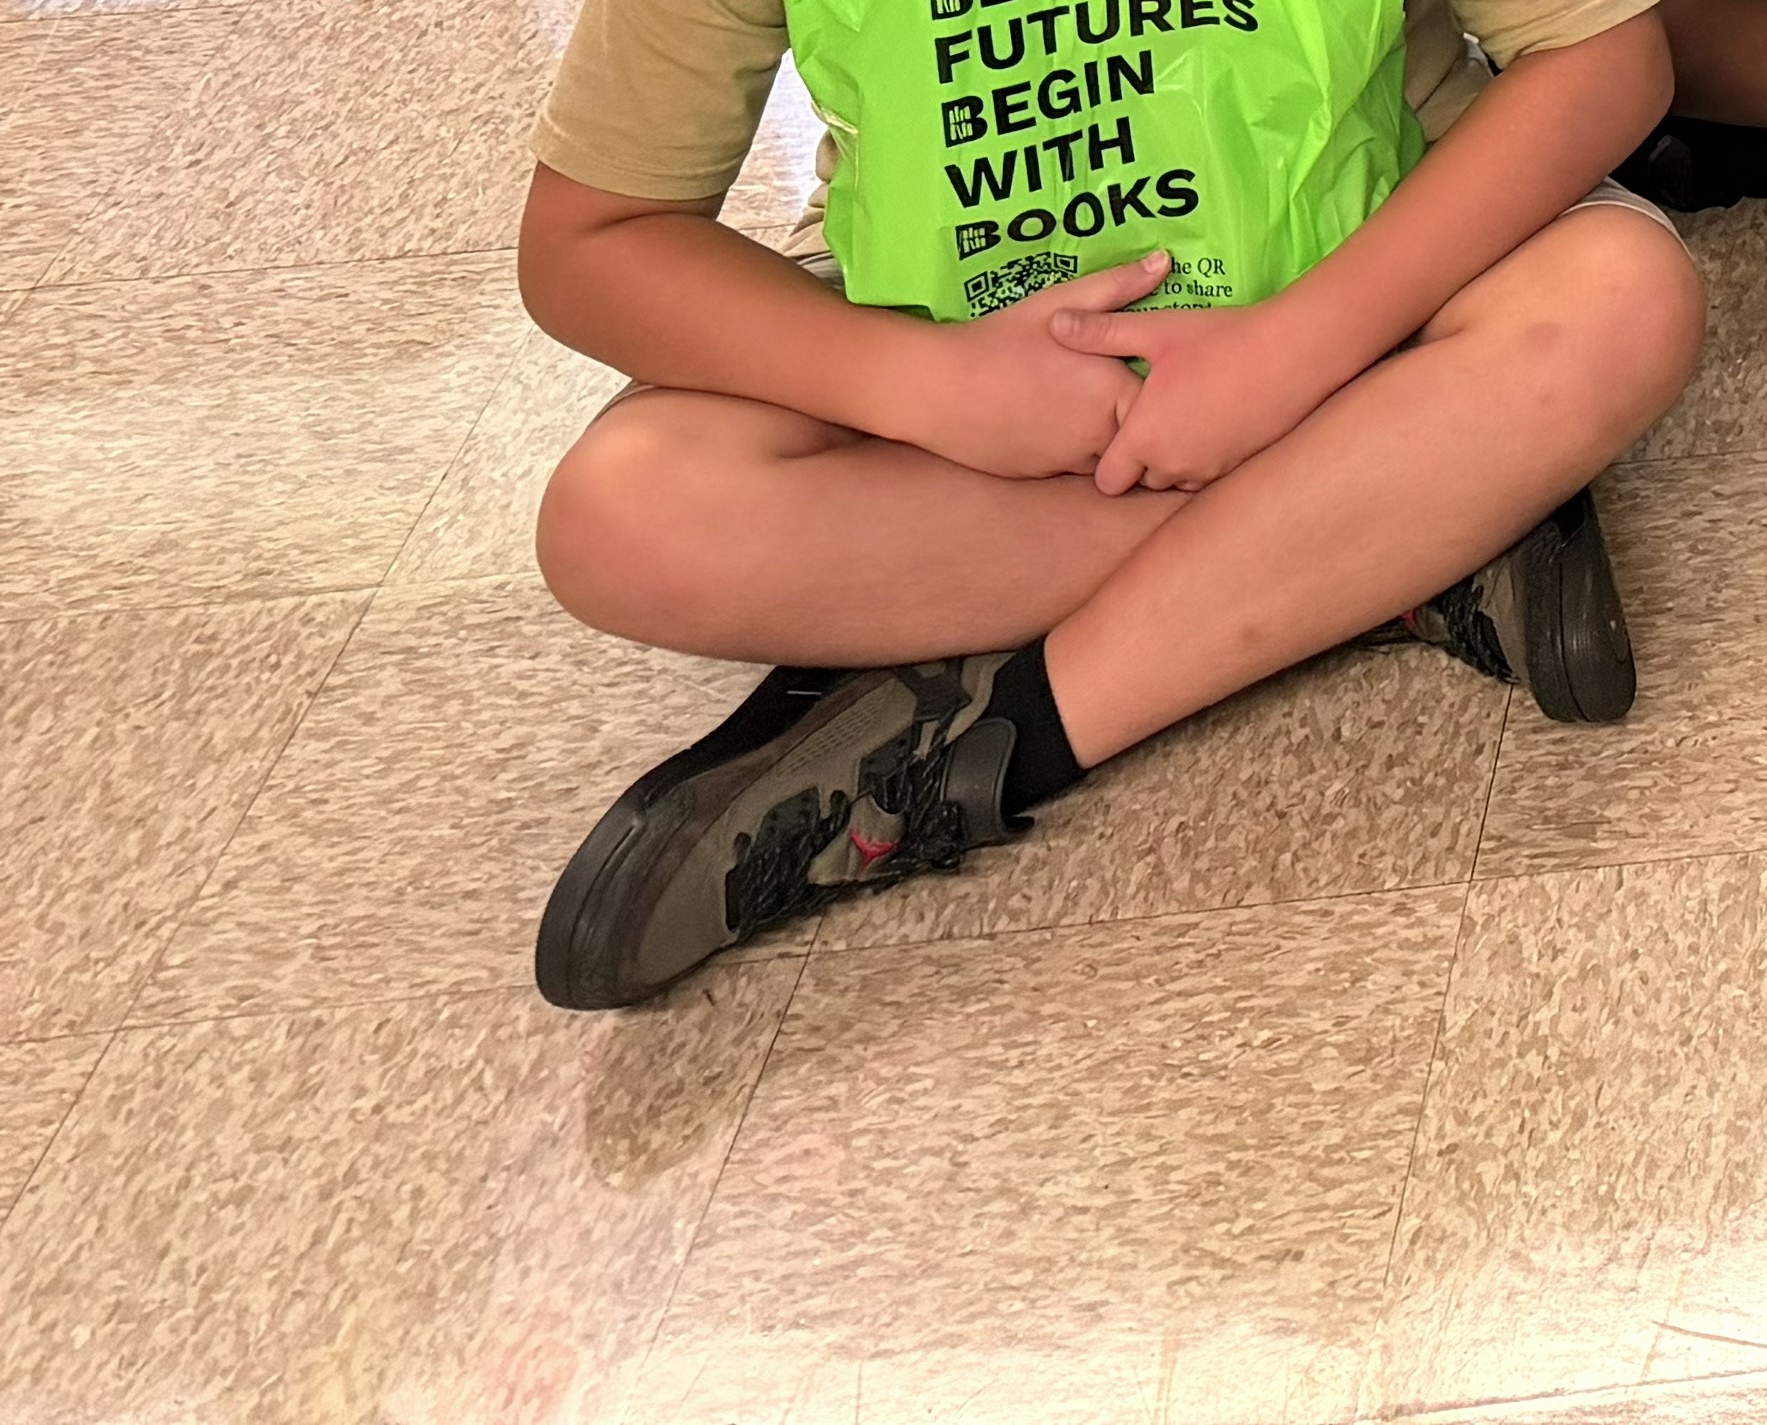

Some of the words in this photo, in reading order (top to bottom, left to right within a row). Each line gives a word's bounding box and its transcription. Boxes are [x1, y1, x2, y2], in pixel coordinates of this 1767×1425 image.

[942, 50, 1154, 148] BEGIN
[944, 117, 1136, 209] WITH
[956, 168, 1200, 260] BOOKS
